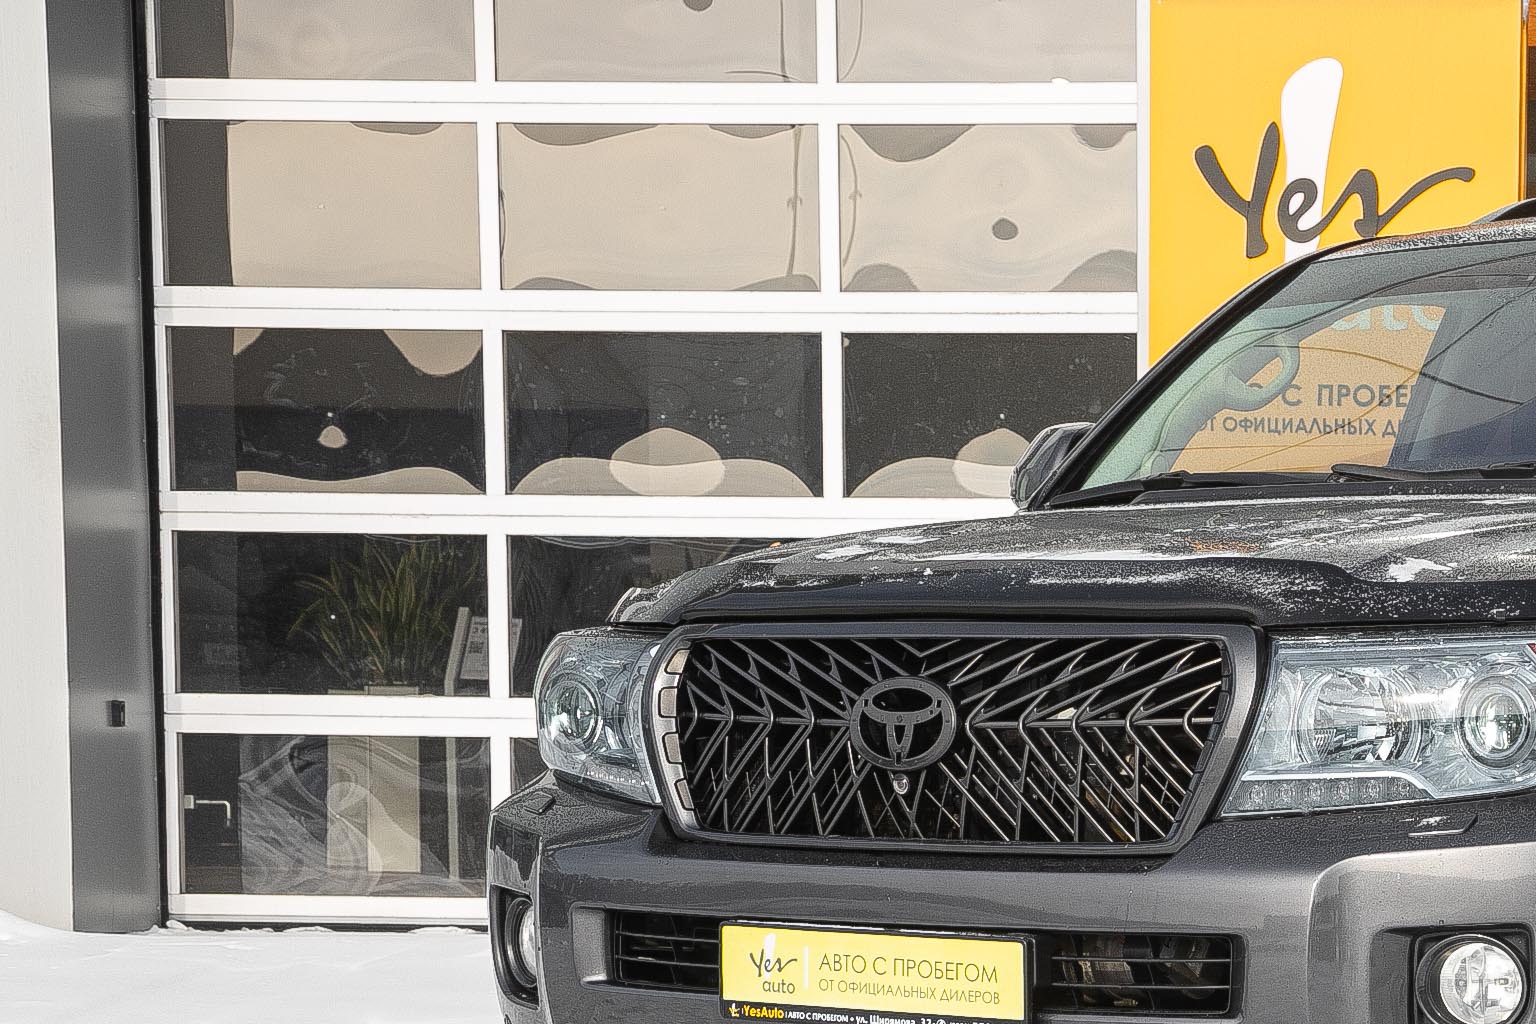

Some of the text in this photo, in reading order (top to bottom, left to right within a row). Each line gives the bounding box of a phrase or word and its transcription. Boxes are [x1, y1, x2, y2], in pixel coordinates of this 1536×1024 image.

[1194, 121, 1476, 259] Yes
[1317, 384, 1413, 409] ПРОБЕ
[1222, 416, 1377, 438] ОФИЦИАЛЬНЫХ
[749, 948, 798, 977] Yes
[818, 952, 998, 984] АВТО С ПРОБЕГОМ
[762, 978, 796, 995] auto
[818, 978, 1001, 1005] ОТ ОФИЦИАЛЬНЫХ ДИЛЕРОВ
